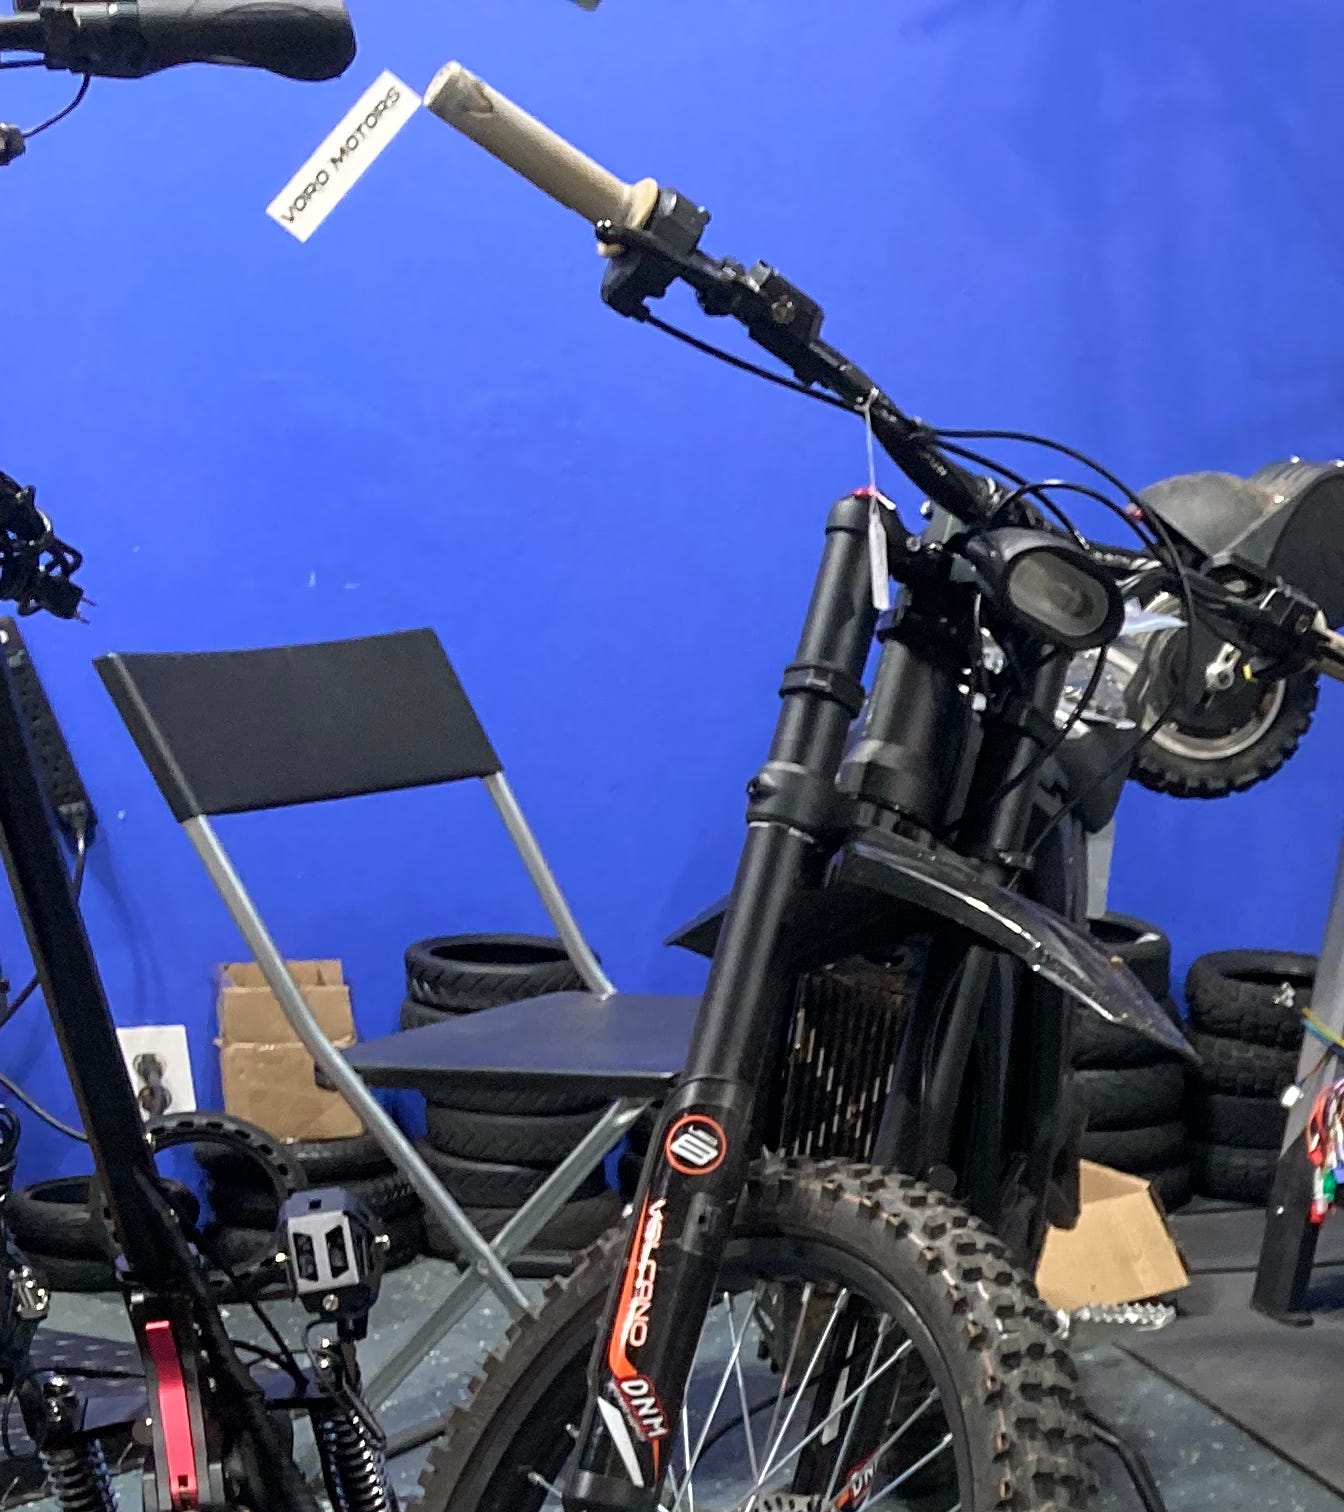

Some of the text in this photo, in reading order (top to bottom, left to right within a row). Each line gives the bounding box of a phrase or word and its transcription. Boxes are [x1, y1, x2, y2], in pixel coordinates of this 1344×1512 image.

[282, 86, 400, 223] VORO MOTORS
[621, 1378, 670, 1438] DNM
